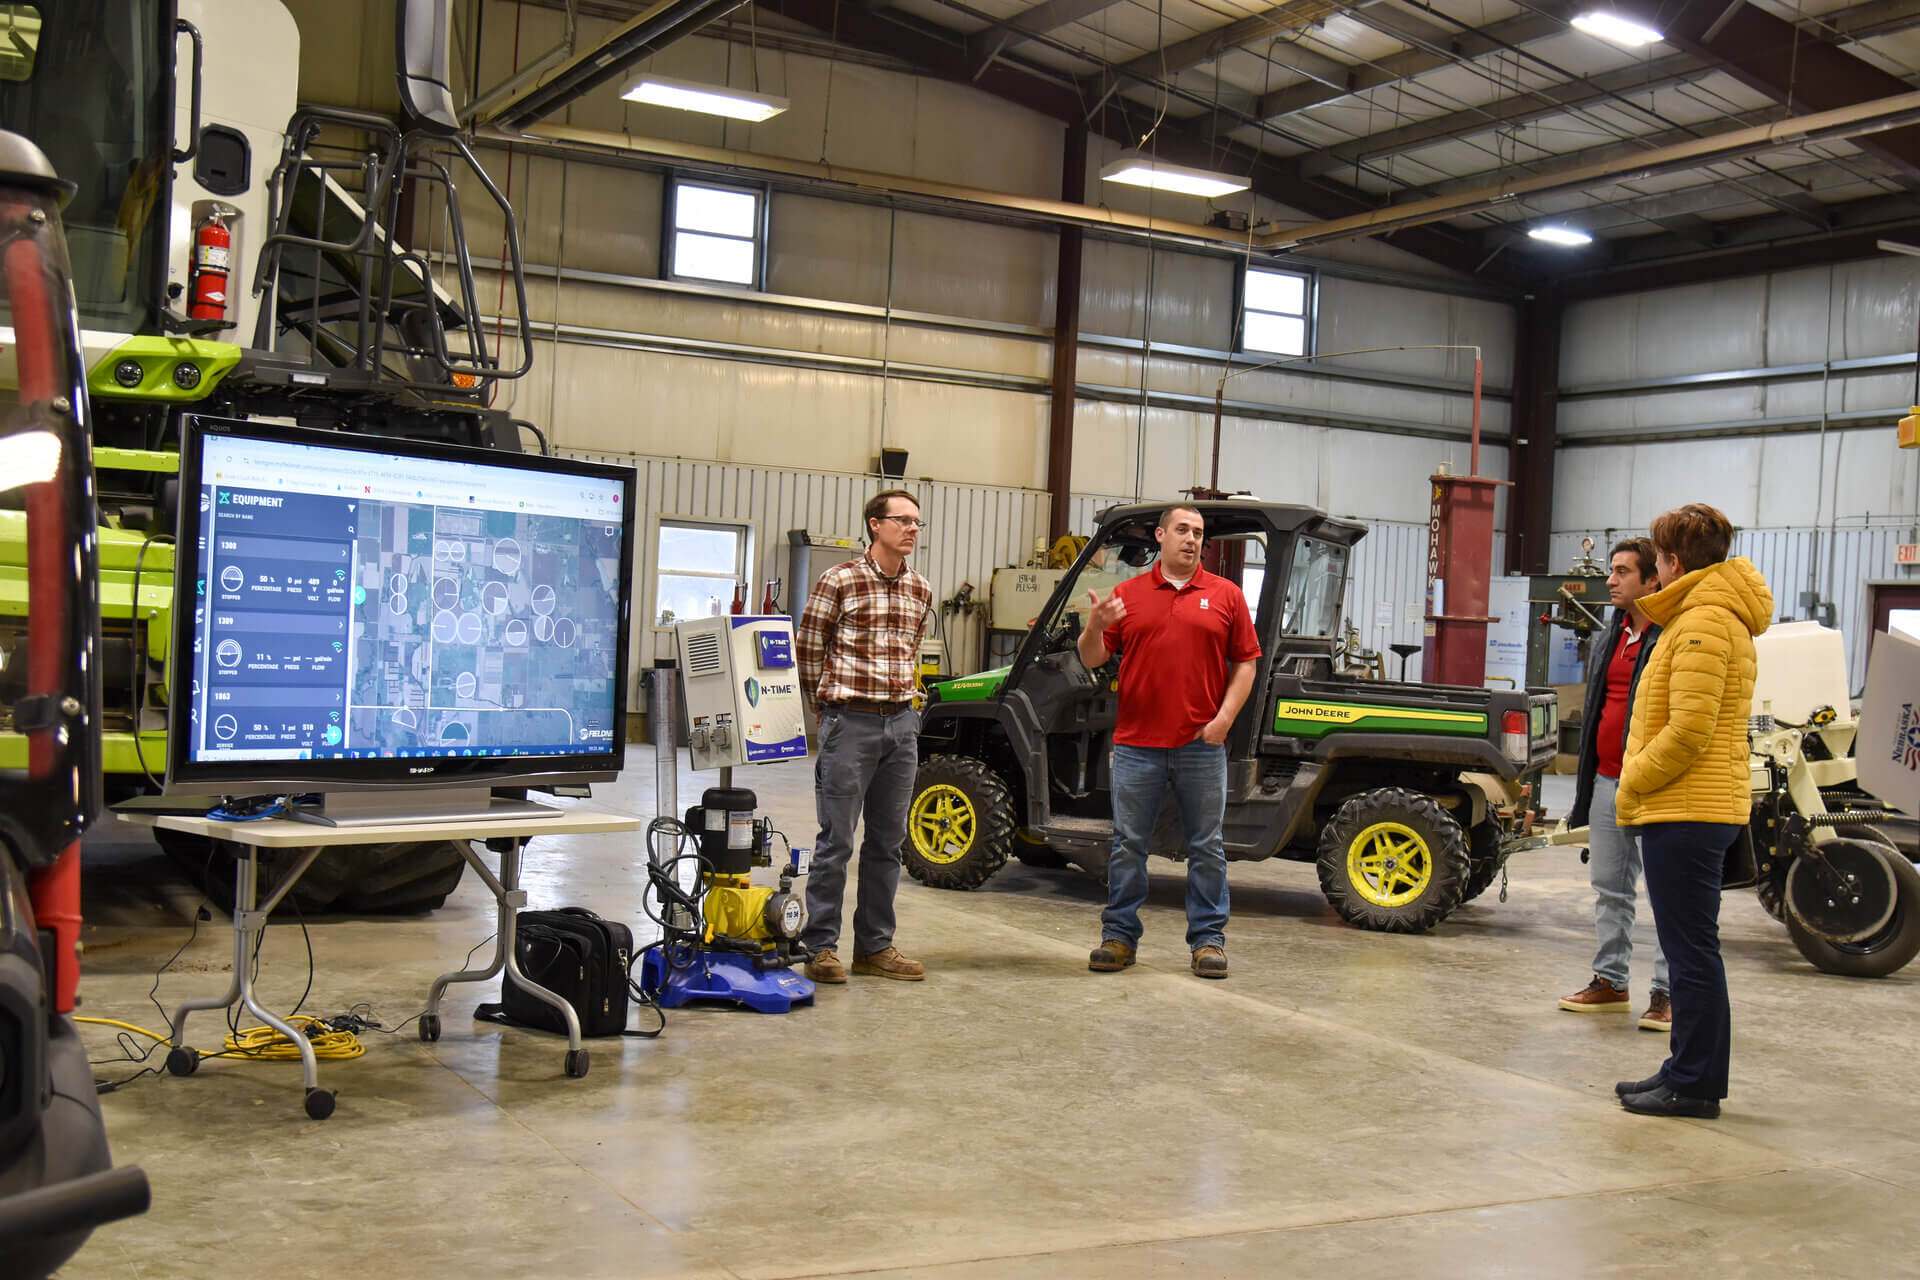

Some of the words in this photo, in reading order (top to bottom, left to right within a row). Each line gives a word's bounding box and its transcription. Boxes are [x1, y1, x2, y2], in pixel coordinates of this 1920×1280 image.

[232, 494, 284, 508] EQUIPMENT
[1428, 504, 1440, 587] MOHAWK
[1897, 544, 1917, 562] EXIT
[761, 684, 792, 695] N-TIME
[1285, 706, 1313, 716] JOHN
[1315, 708, 1351, 718] DEERE
[1892, 703, 1912, 764] NEBRASKA
